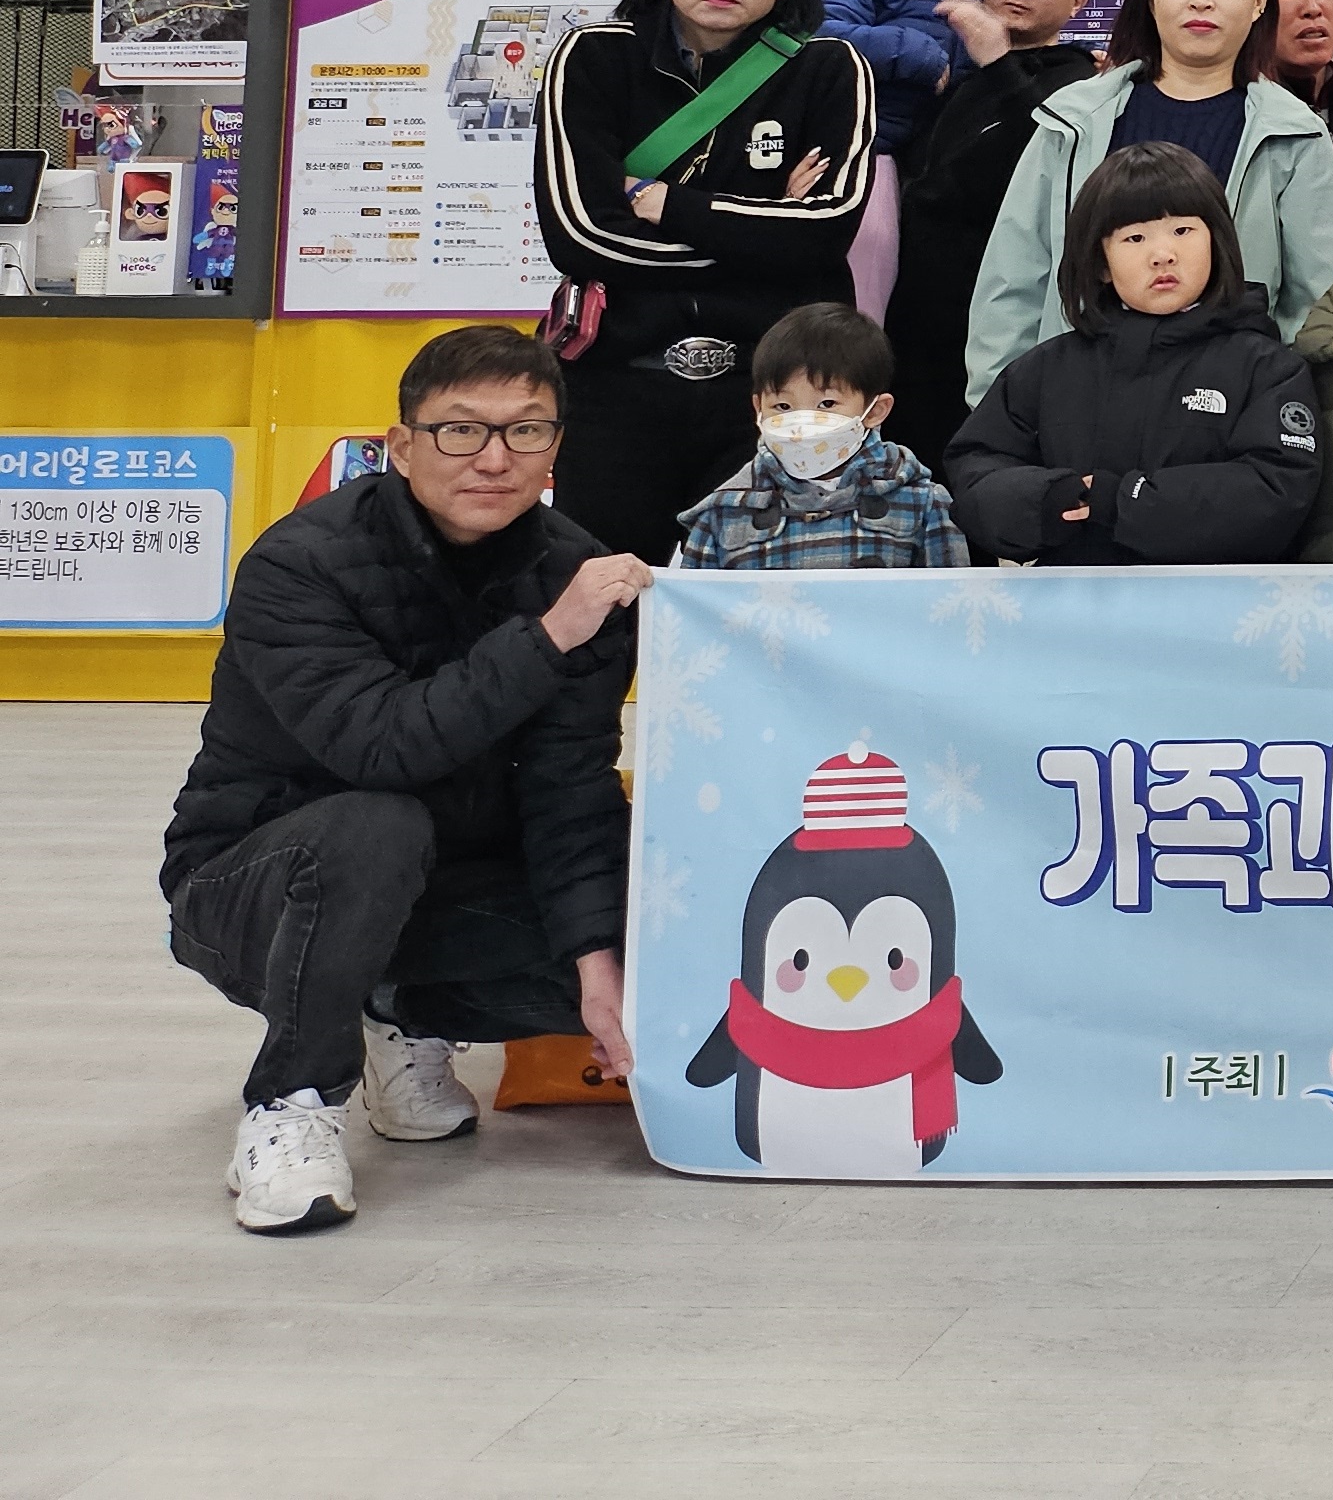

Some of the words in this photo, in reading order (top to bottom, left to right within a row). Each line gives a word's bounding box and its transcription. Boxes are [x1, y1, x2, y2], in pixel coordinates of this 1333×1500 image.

[1085, 10, 1104, 18] 1,000
[1087, 21, 1101, 29] 500
[320, 67, 354, 77] 운영시간
[361, 67, 386, 76] 10:00
[396, 66, 421, 76] 17:00
[308, 118, 322, 126] 성인
[302, 208, 317, 216] 유아
[120, 263, 157, 272] Heroes
[1195, 388, 1213, 398] THE
[1181, 395, 1212, 405] NORTH
[1187, 403, 1213, 412] FACE
[0, 446, 198, 485] 어리얼로프코스
[11, 500, 68, 522] 130cm
[76, 500, 118, 524] 이상
[125, 499, 162, 524] 이용
[166, 500, 203, 524] 가능
[0, 529, 49, 553] 학년은
[53, 530, 125, 554] 보호자와
[132, 530, 163, 554] 함께
[168, 530, 201, 555] 이용
[0, 557, 84, 581] 탁드립니다.
[1187, 1054, 1260, 1098] 주최
